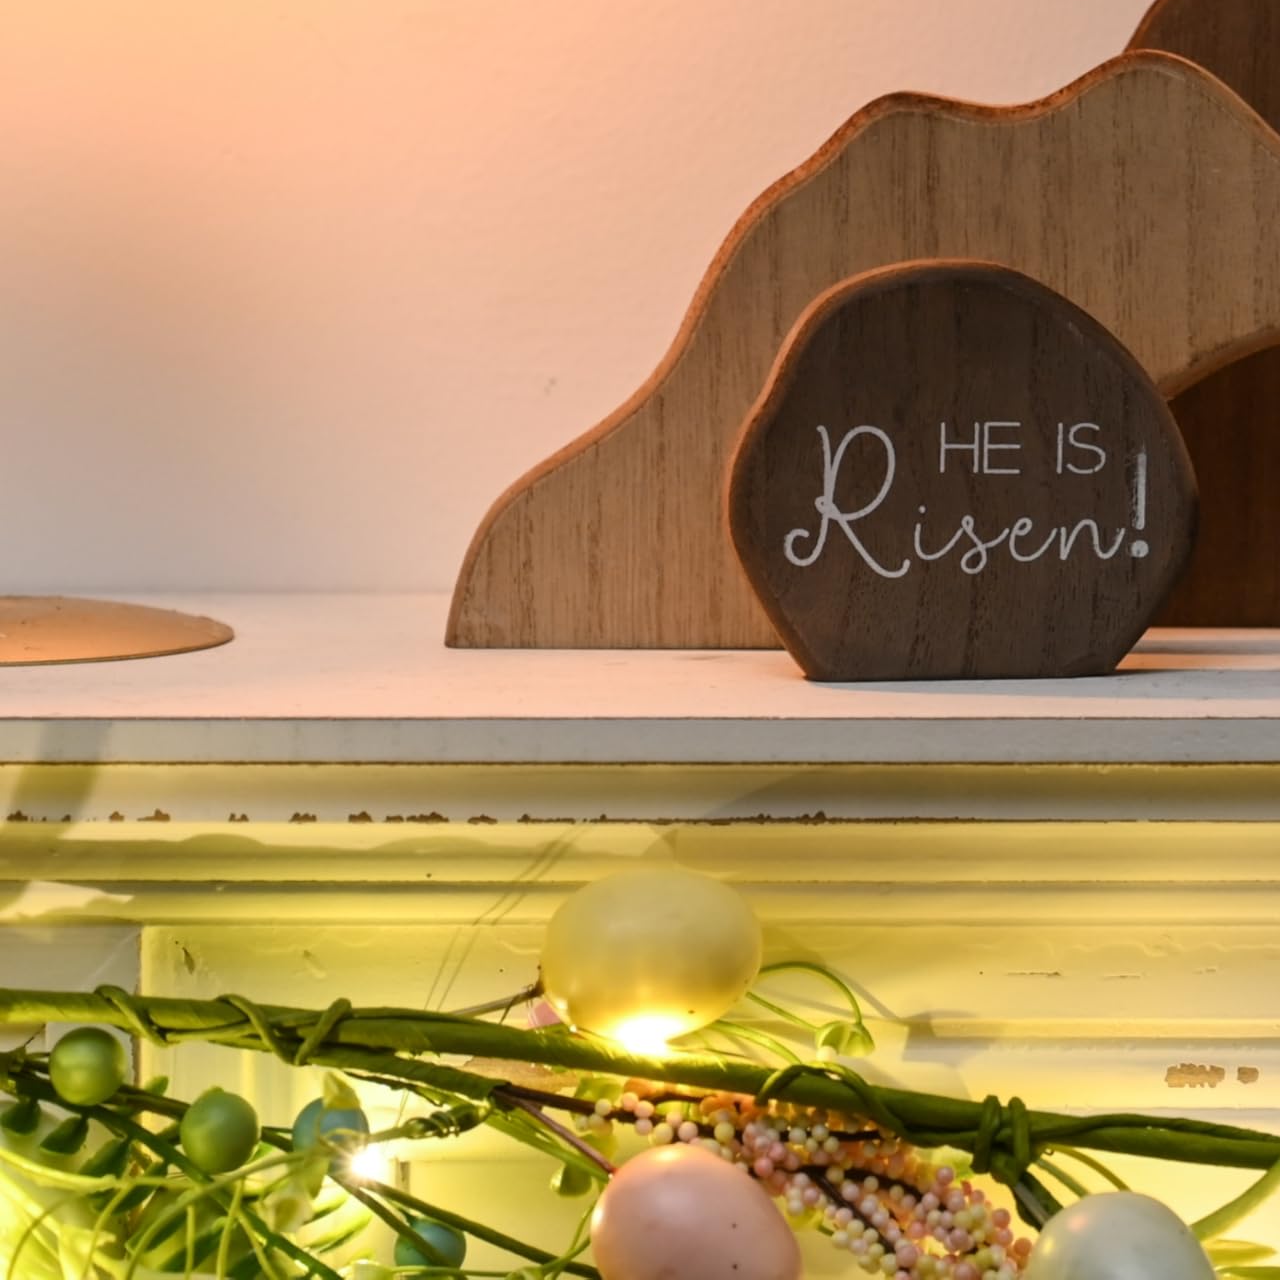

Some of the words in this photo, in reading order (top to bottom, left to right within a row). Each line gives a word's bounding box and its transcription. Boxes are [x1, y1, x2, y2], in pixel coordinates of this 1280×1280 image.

[938, 421, 1022, 475] HE
[1056, 422, 1106, 475] IS
[783, 424, 1150, 578] Risen!
